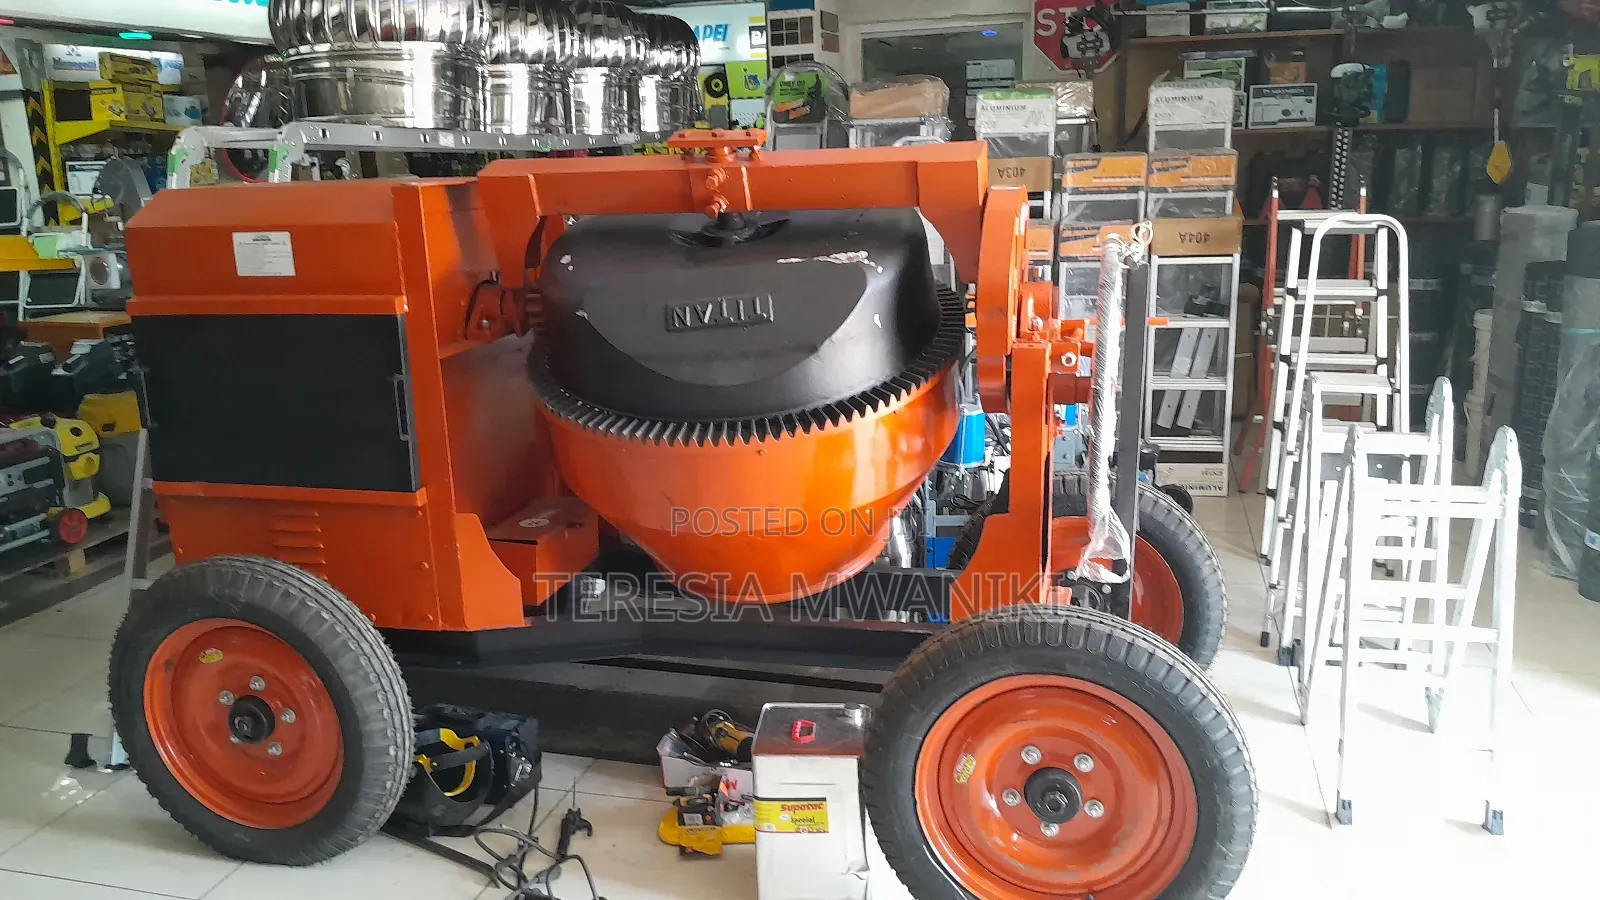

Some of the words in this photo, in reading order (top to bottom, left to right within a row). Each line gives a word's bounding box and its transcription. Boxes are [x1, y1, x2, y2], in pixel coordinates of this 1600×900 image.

[1036, 5, 1103, 37] ST
[694, 24, 729, 42] APEI
[1155, 94, 1204, 103] ALUMINIUM
[980, 104, 1027, 112] ALUMINIUM
[996, 166, 1026, 179] 403A
[1177, 231, 1211, 244] 404A
[672, 295, 769, 327] TITAN
